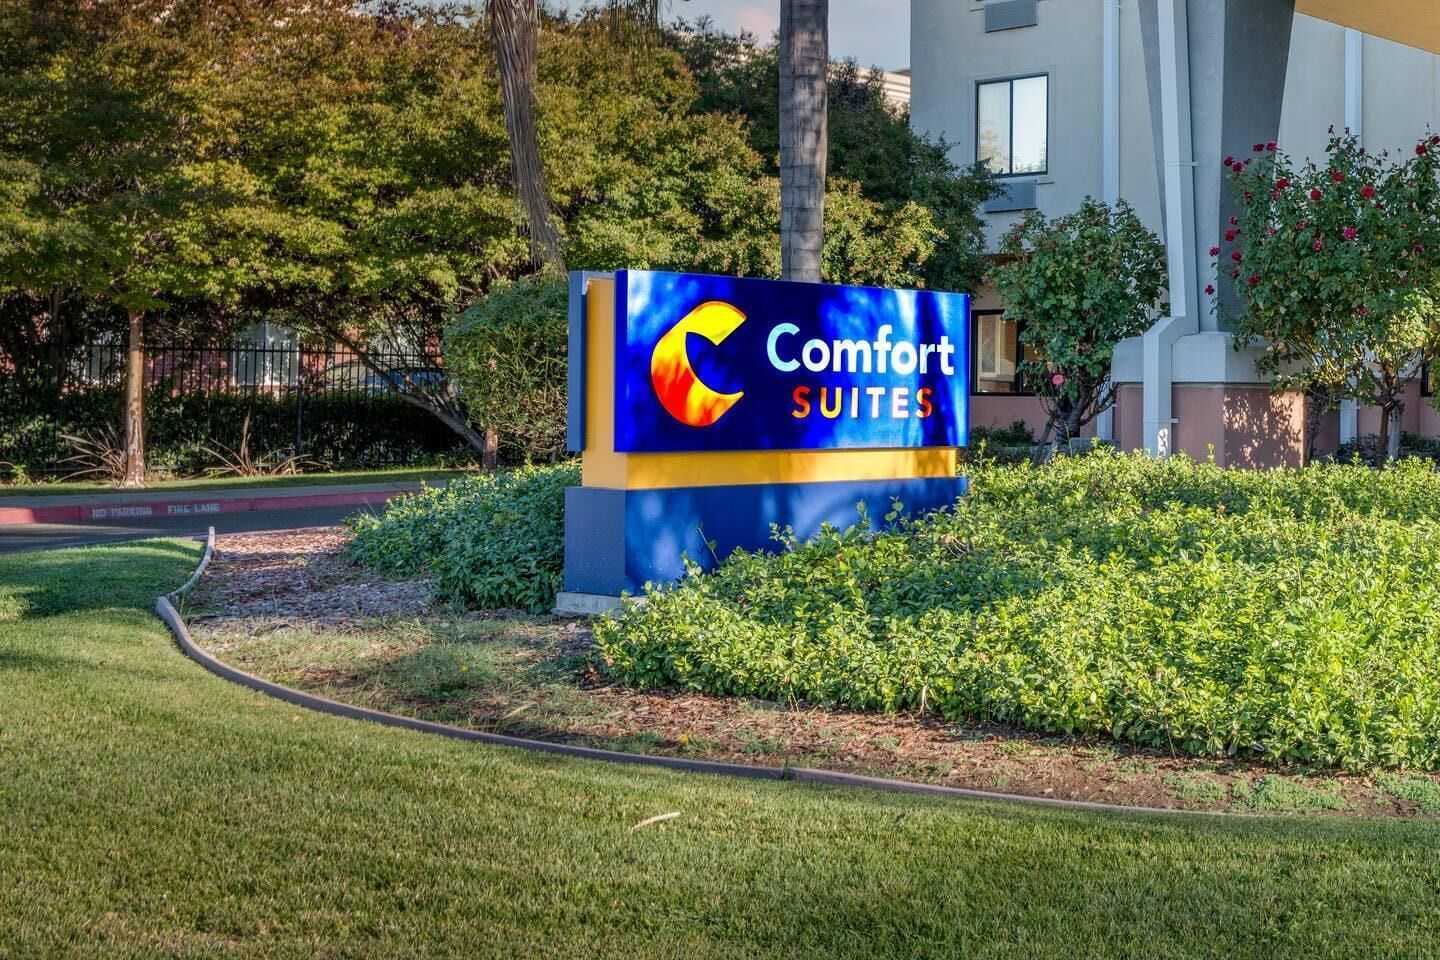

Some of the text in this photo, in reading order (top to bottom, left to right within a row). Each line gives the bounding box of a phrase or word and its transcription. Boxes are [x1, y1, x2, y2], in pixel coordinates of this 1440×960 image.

[766, 322, 955, 376] Comfort
[791, 385, 933, 420] SUITES
[92, 503, 220, 518] NO PARKING FIRE LANE
